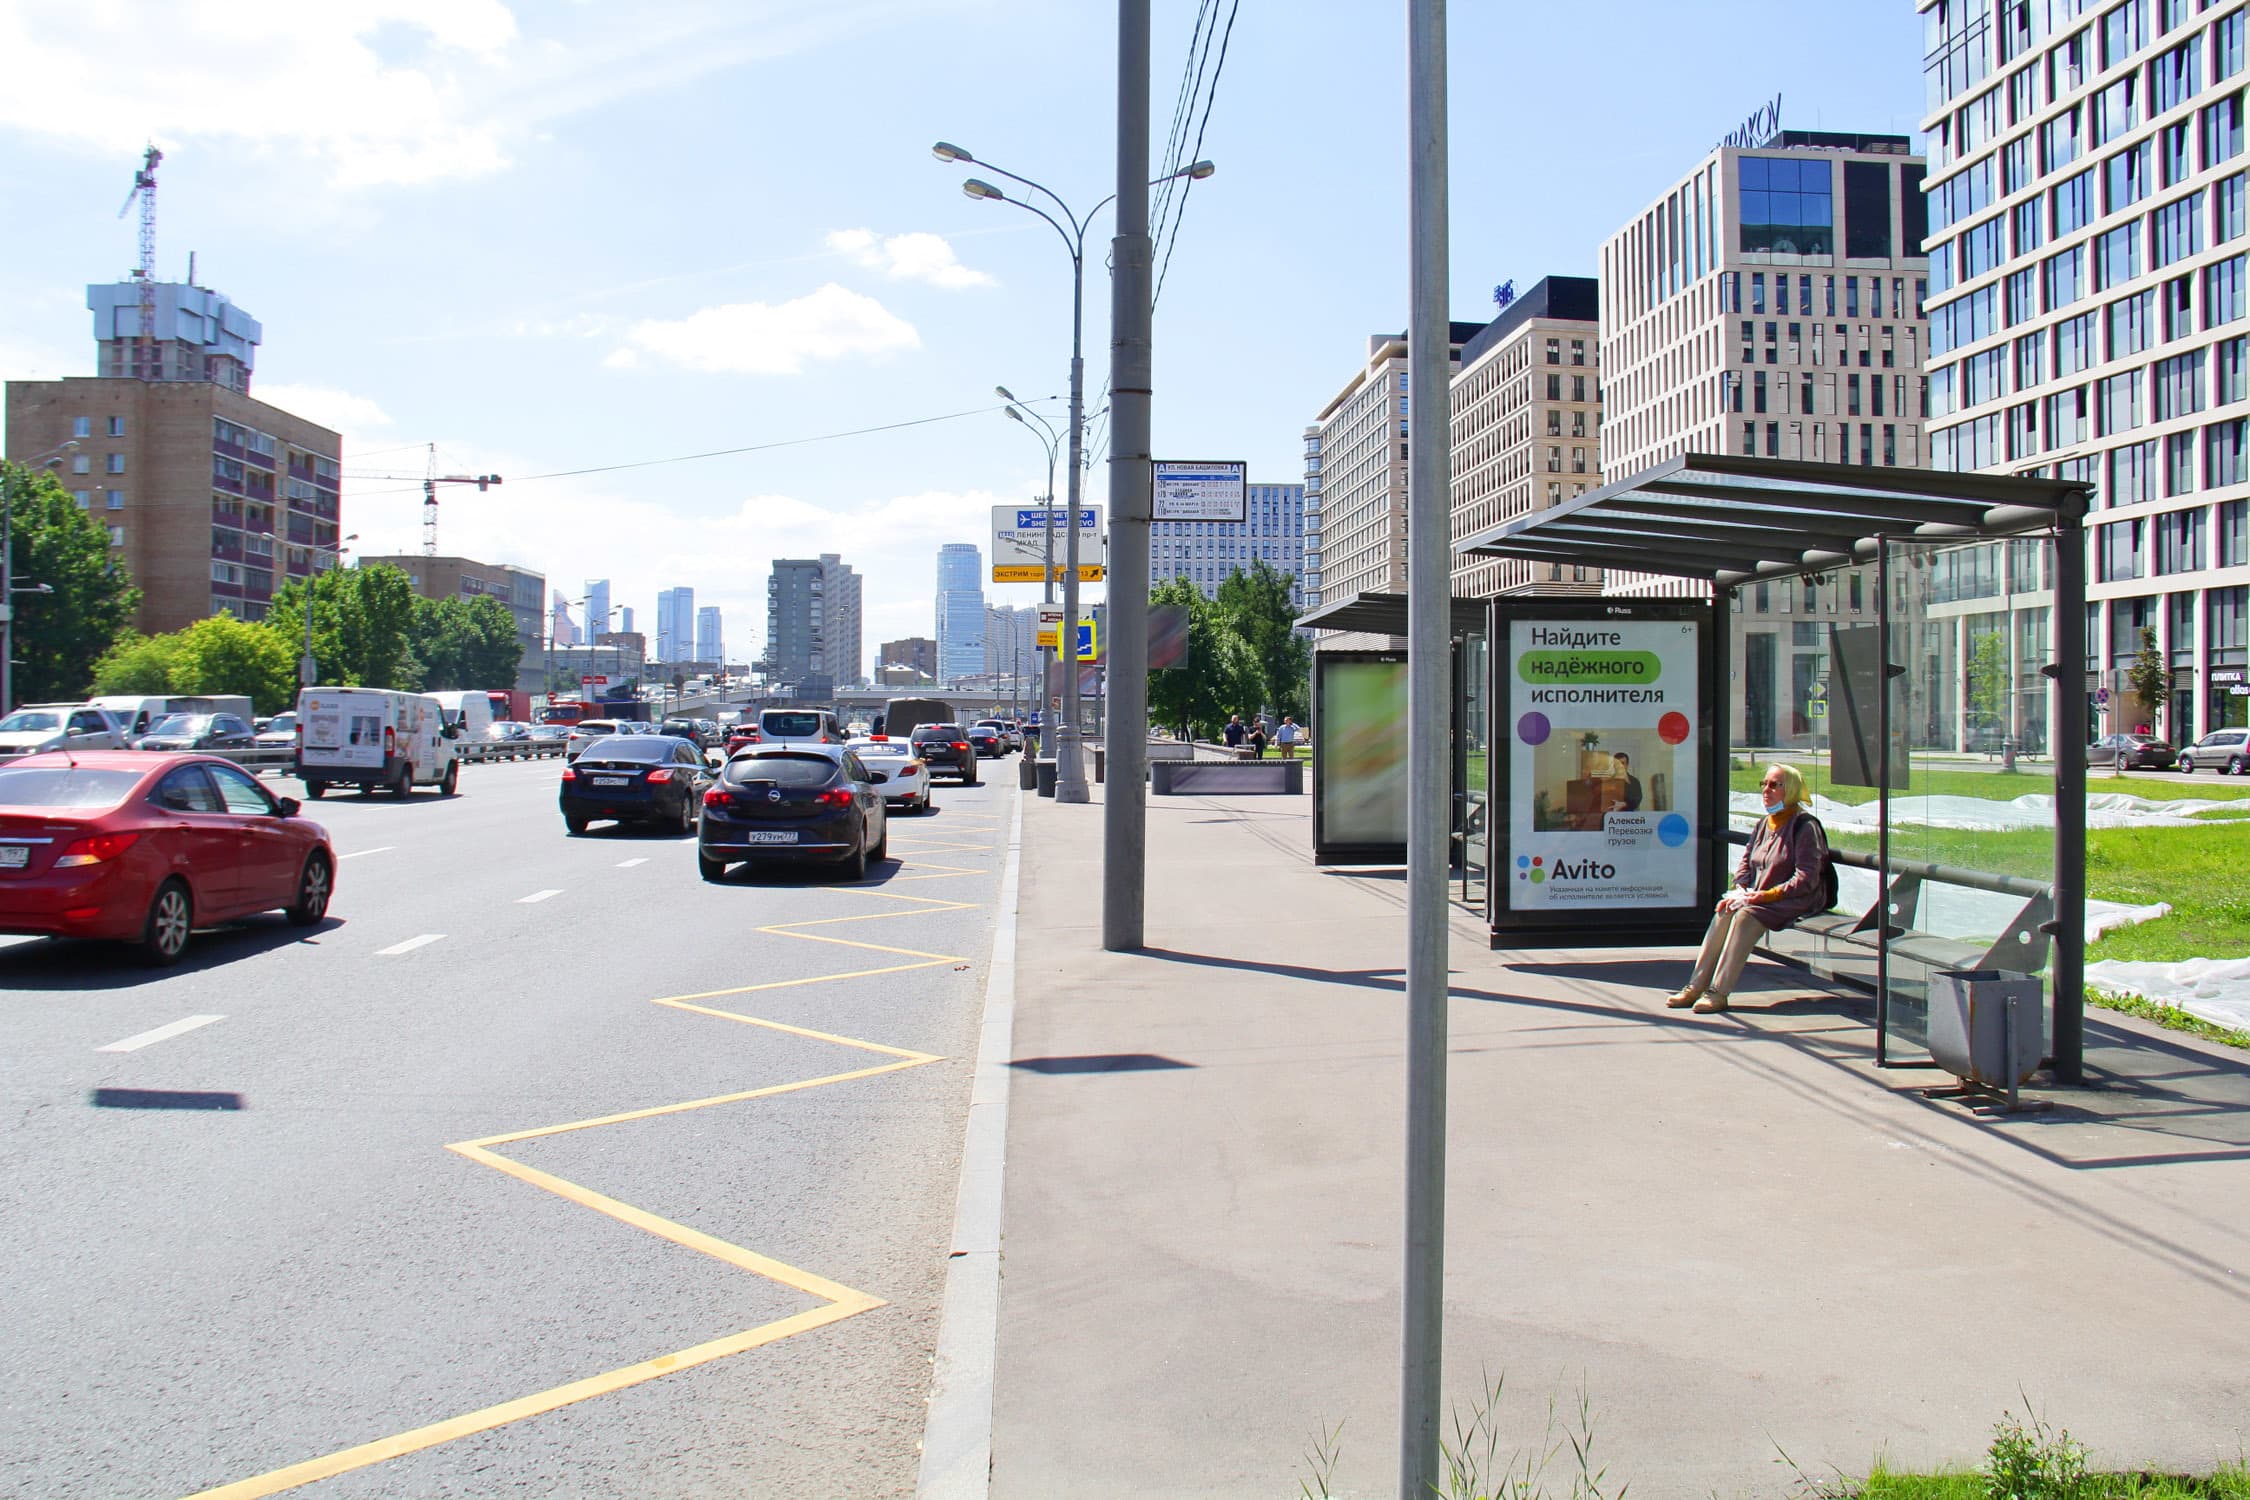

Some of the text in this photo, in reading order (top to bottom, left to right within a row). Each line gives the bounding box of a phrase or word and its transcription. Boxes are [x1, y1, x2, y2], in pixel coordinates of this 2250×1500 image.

[1681, 625, 1693, 634] 6+
[1531, 627, 1621, 649] Найдите
[1531, 657, 1645, 678] надёжного
[1531, 688, 1664, 703] исполнителя
[1608, 816, 1646, 825] Алексей
[1608, 827, 1653, 836] Перевозка
[1607, 838, 1636, 847] грузов
[1551, 858, 1616, 879] Avito
